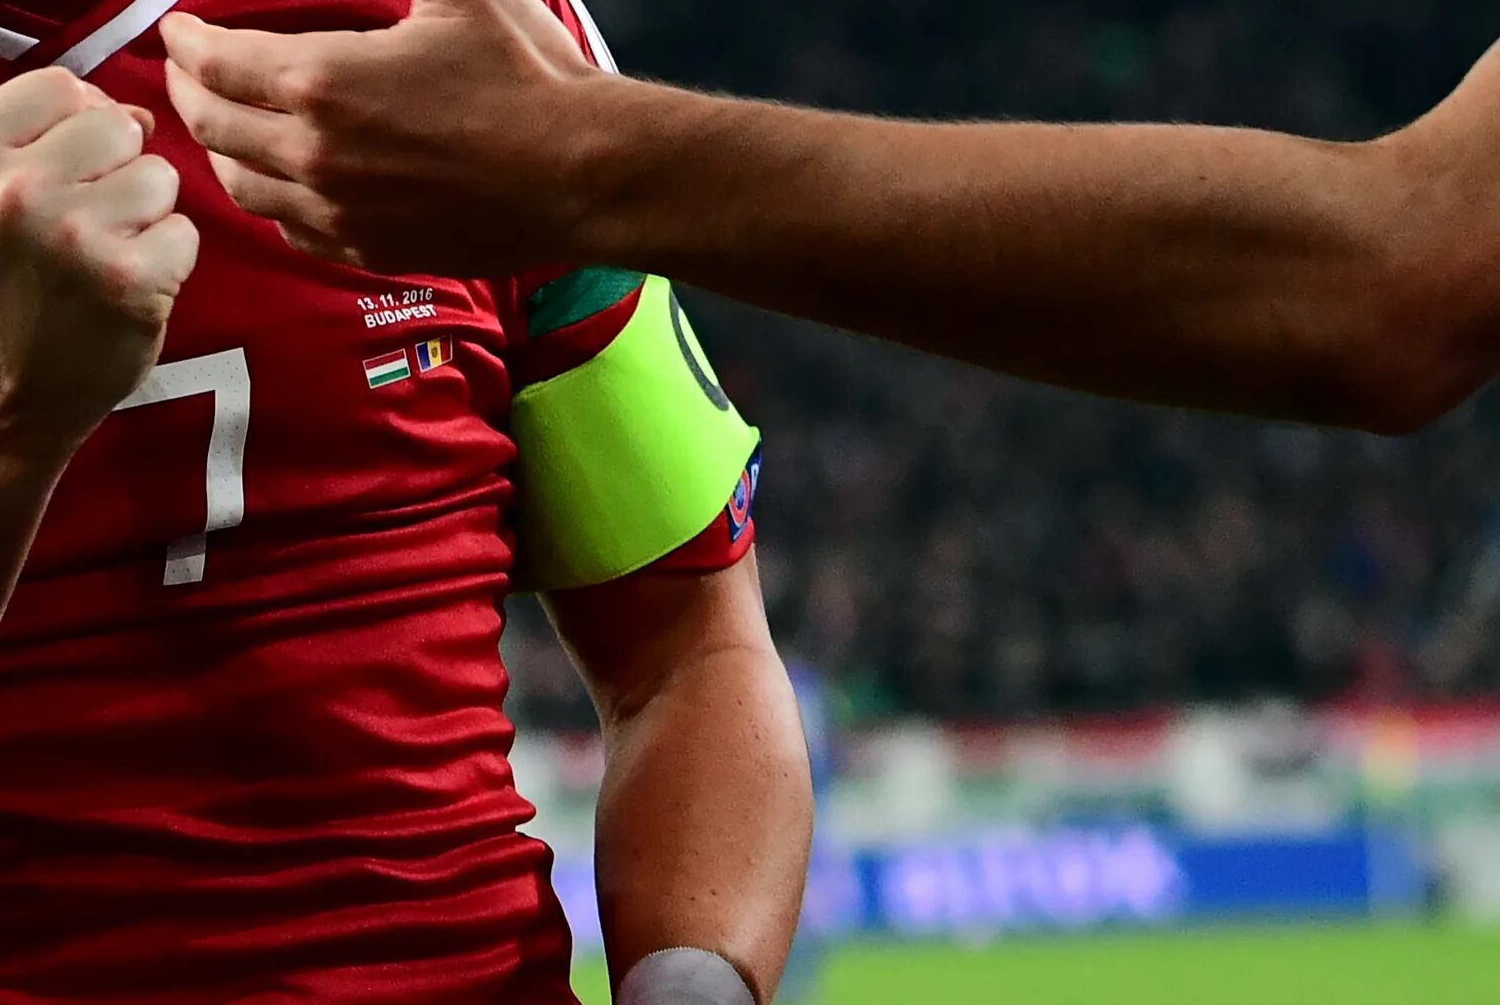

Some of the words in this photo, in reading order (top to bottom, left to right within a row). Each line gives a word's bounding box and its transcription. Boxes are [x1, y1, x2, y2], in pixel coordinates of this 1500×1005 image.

[357, 297, 379, 311] 13.
[379, 293, 399, 308] 11.
[402, 287, 433, 304] 2016
[364, 304, 437, 328] BUDAPEST
[111, 346, 251, 586] 7
